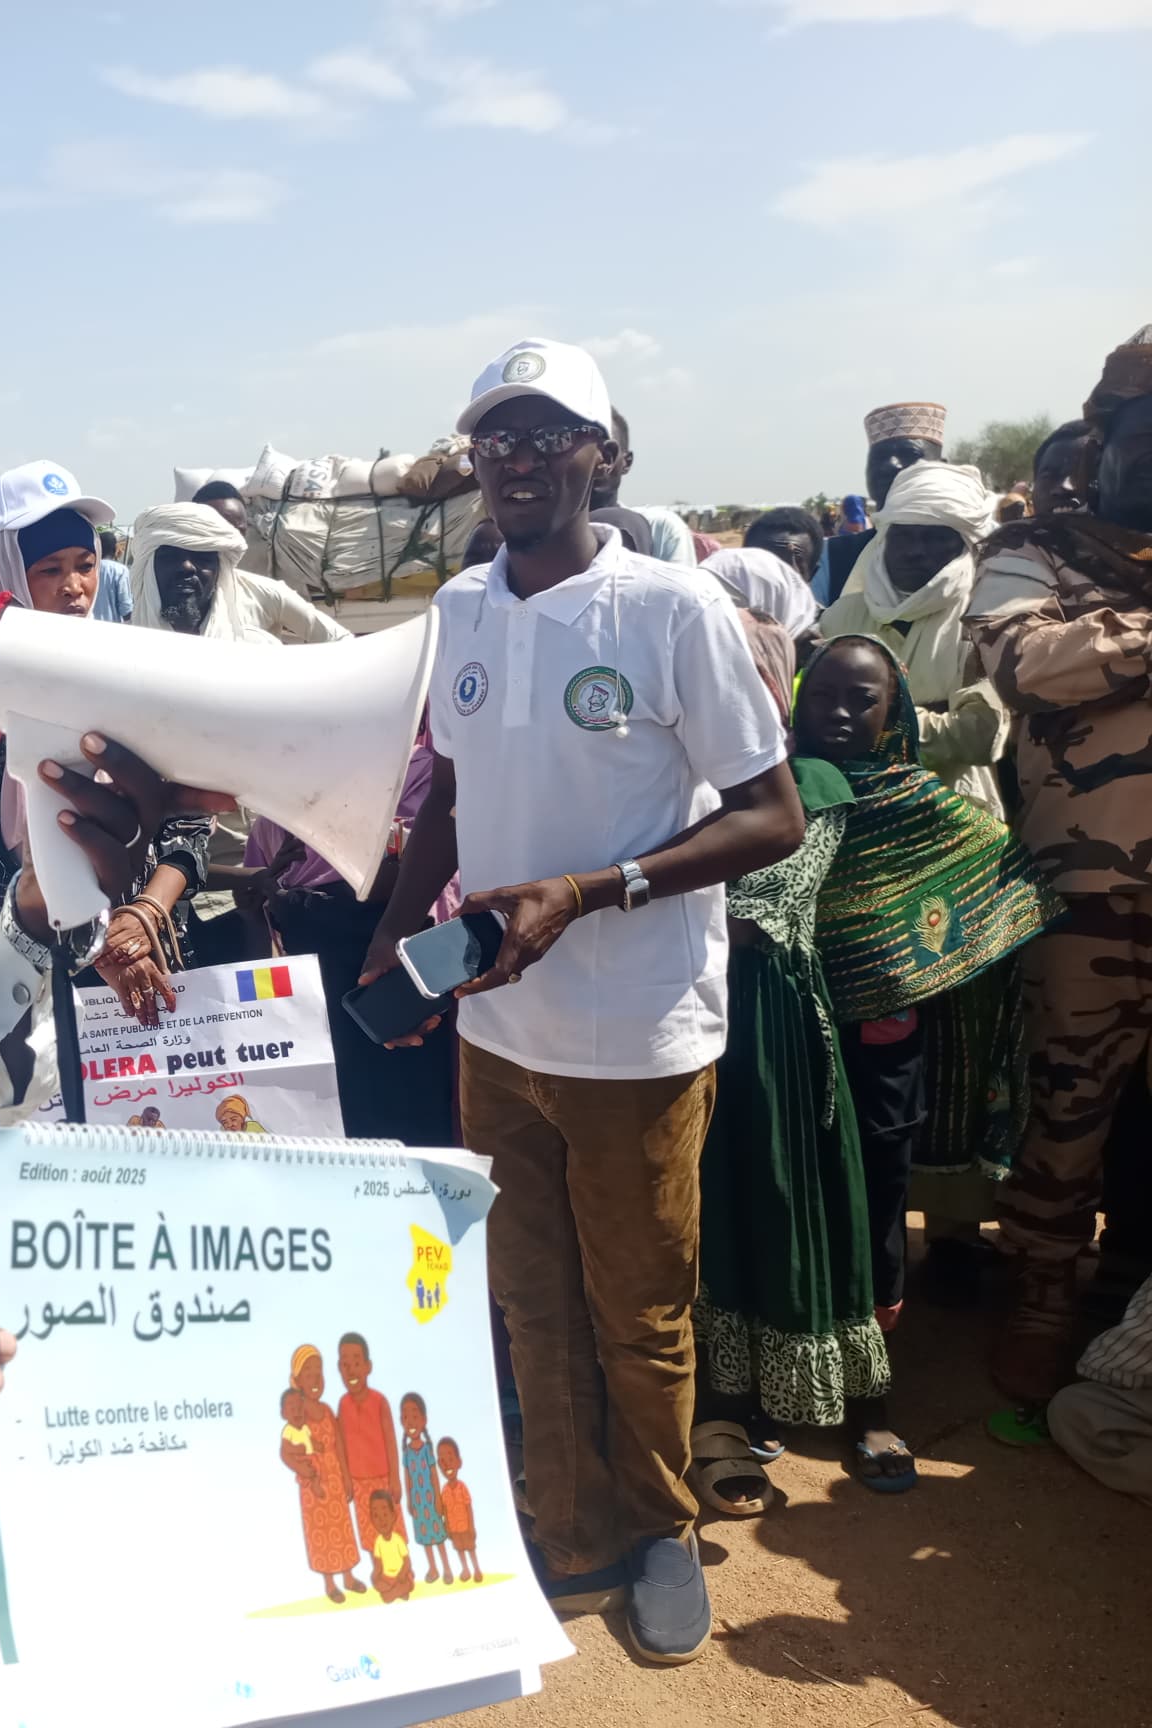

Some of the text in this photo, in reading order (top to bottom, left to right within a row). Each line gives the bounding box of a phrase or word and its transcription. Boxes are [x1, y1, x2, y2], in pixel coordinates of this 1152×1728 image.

[89, 1026, 119, 1039] SANTE
[166, 1018, 177, 1029] ET
[179, 1018, 191, 1028] DE
[193, 1016, 205, 1026] LA
[206, 1008, 263, 1024] PREVENTION
[79, 1034, 191, 1055] وزارة الصحة العام
[166, 1045, 226, 1076] peut
[236, 1040, 294, 1063] tuer
[93, 1071, 244, 1107] الكوليرا مرض
[19, 1162, 68, 1183] Edition
[81, 1165, 111, 1184] août
[115, 1168, 147, 1185] 2025
[363, 1180, 390, 1196] 2025
[11, 1208, 333, 1272] BOÎTE À IMAGES
[416, 1245, 444, 1262] PEV
[15, 1282, 252, 1343] صندوق الصور
[44, 1398, 233, 1428] Lutte contre le cholera
[47, 1431, 188, 1466] مكافحة ضد الكوليرا
